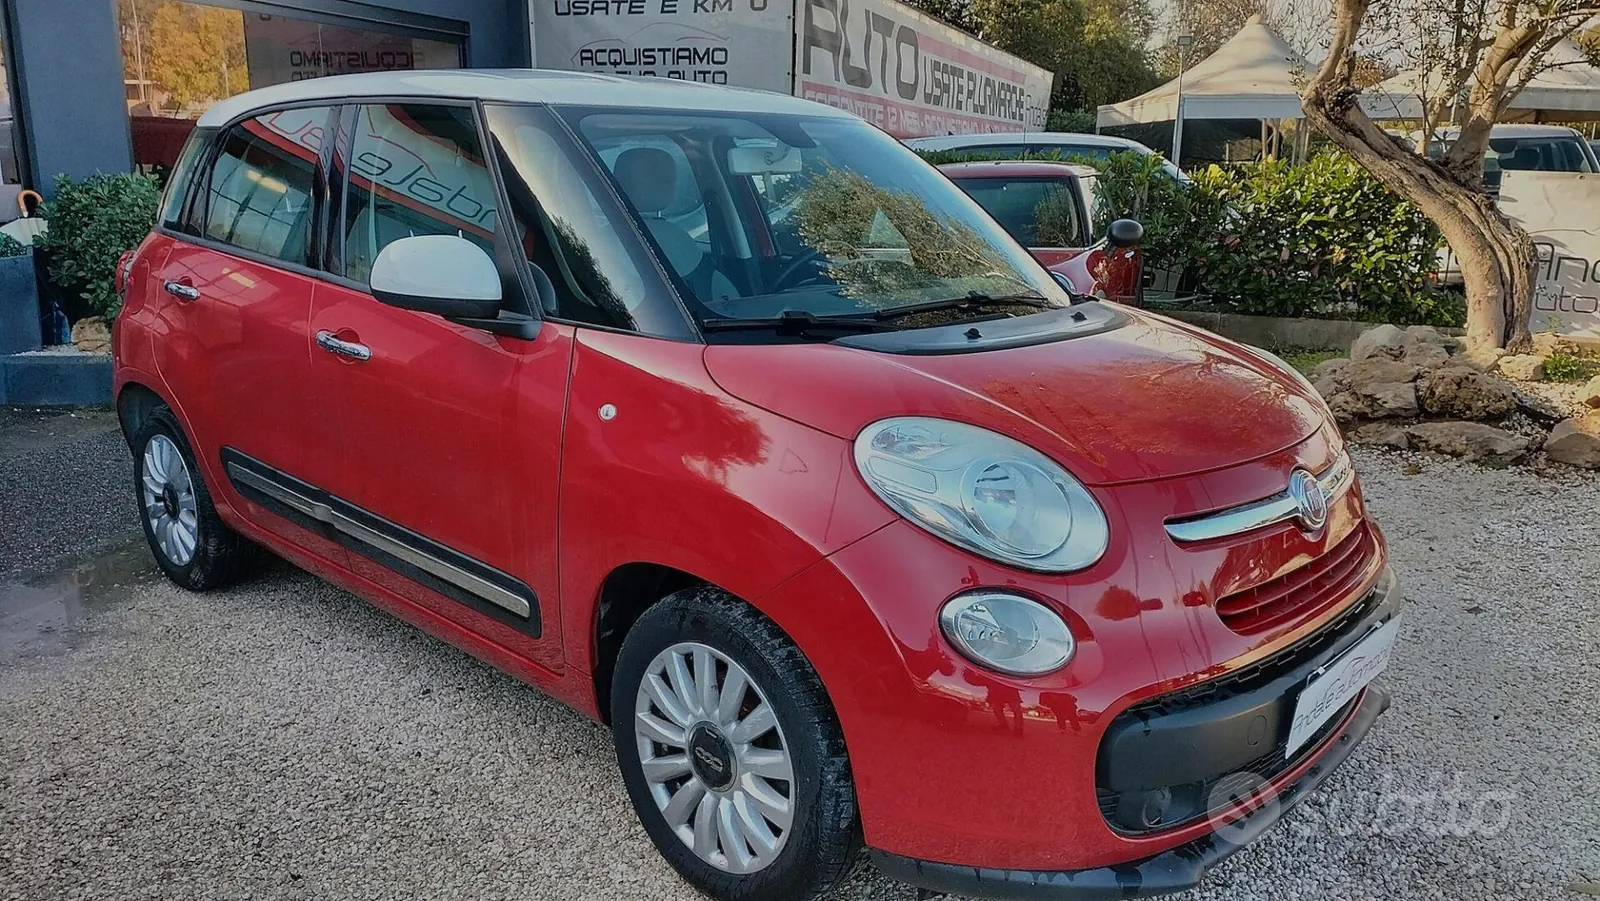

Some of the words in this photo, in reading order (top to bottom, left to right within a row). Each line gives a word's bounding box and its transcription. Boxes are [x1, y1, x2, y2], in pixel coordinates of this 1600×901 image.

[554, 0, 646, 16] USATE
[659, 0, 680, 13] E
[693, 0, 733, 13] KM
[579, 47, 729, 68] ACQUISTIAMO
[802, 0, 919, 101] AUTO
[923, 55, 964, 111] USATE
